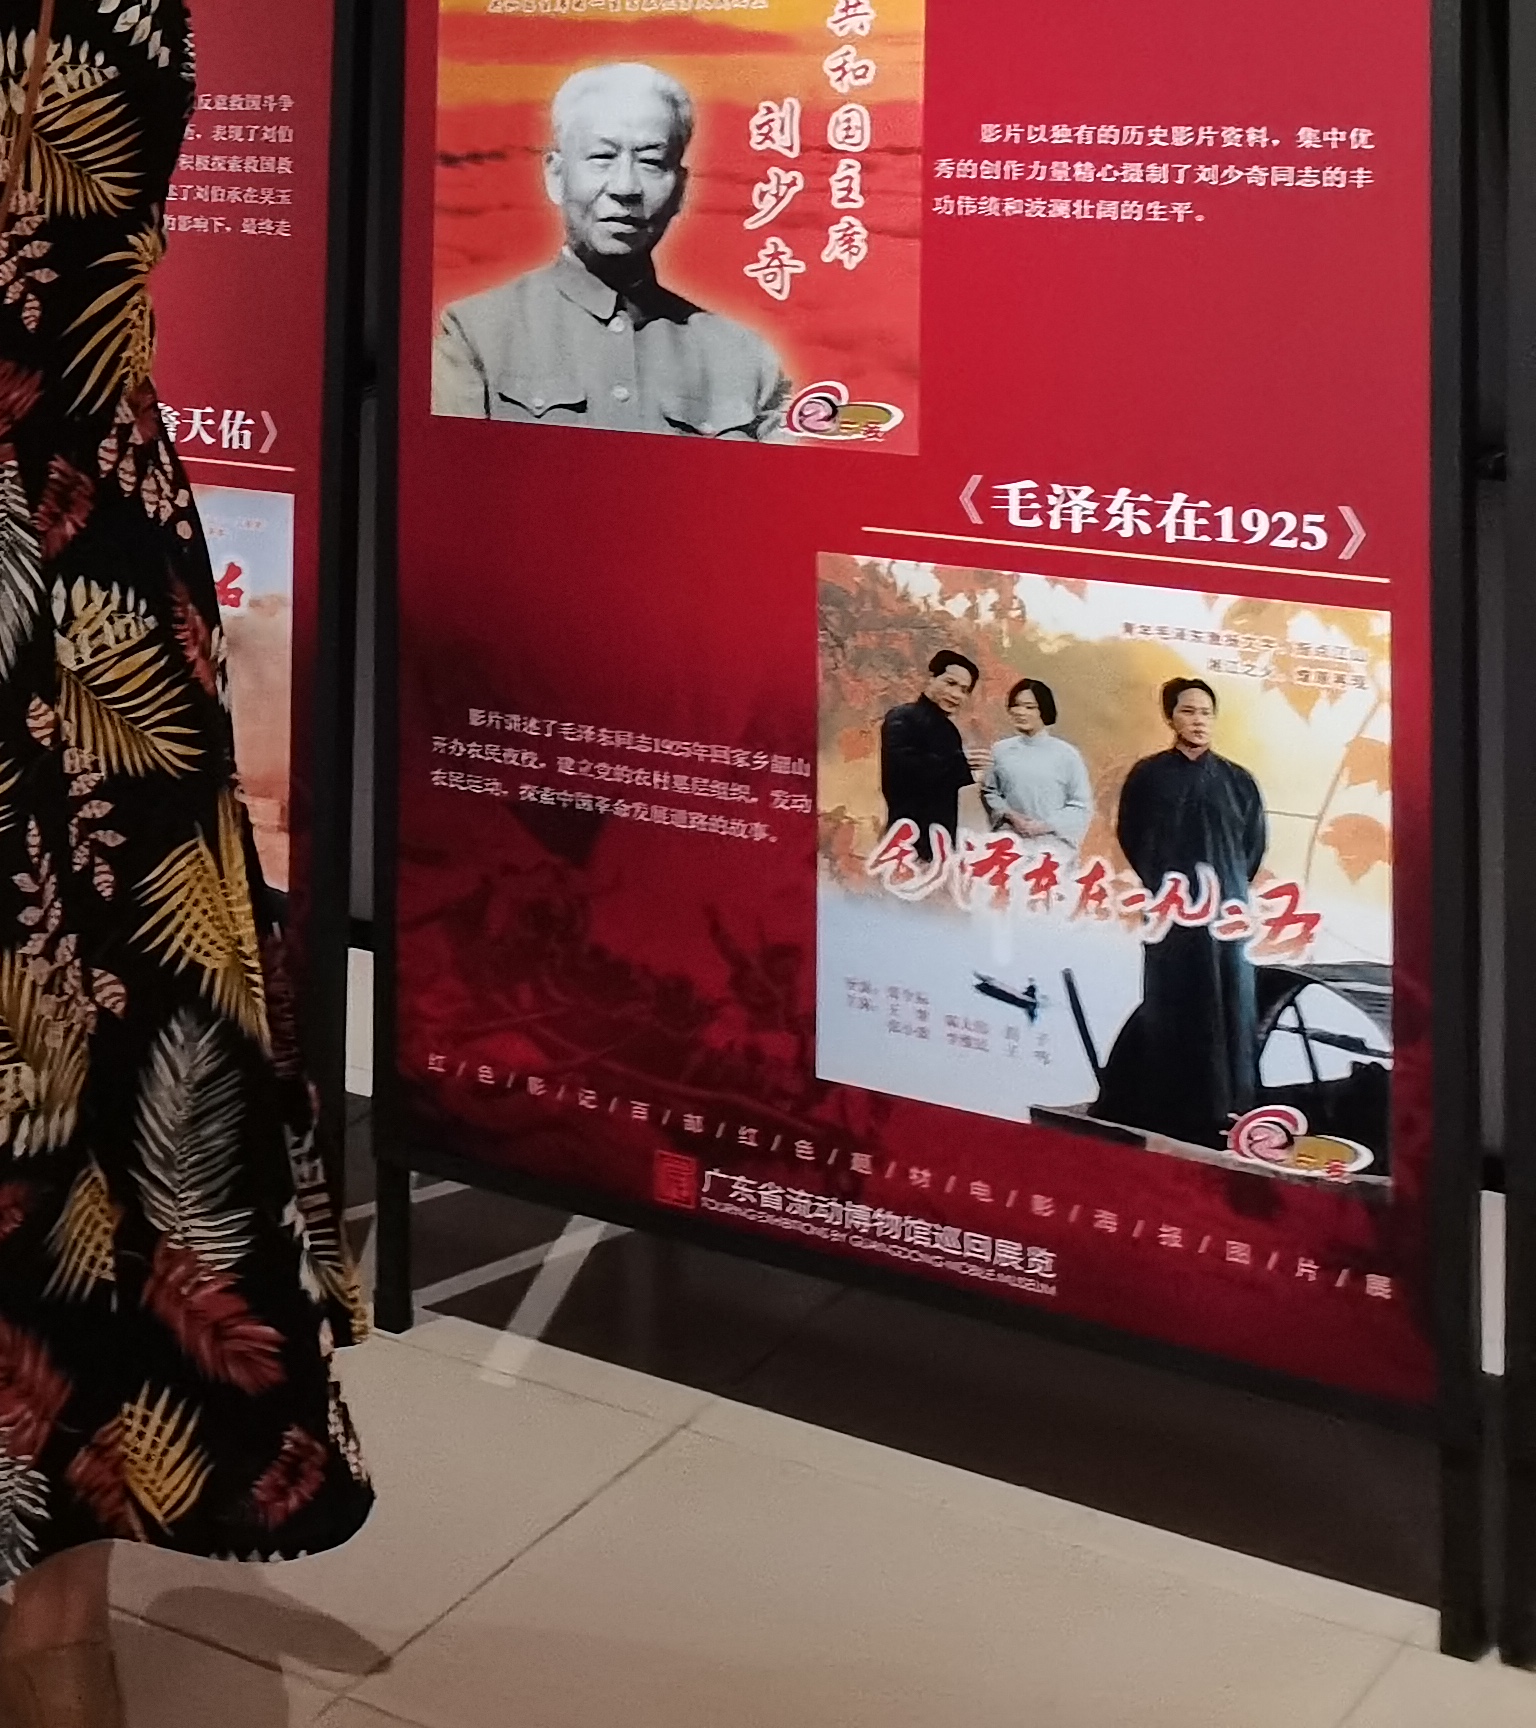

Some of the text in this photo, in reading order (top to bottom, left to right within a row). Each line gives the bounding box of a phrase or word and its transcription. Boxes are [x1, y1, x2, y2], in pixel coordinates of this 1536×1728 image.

[743, 97, 806, 300] 刘少奇
[959, 473, 1368, 561] 《毛泽东在1925》
[701, 1167, 1058, 1278] 广东省流动博物馆巡回展览
